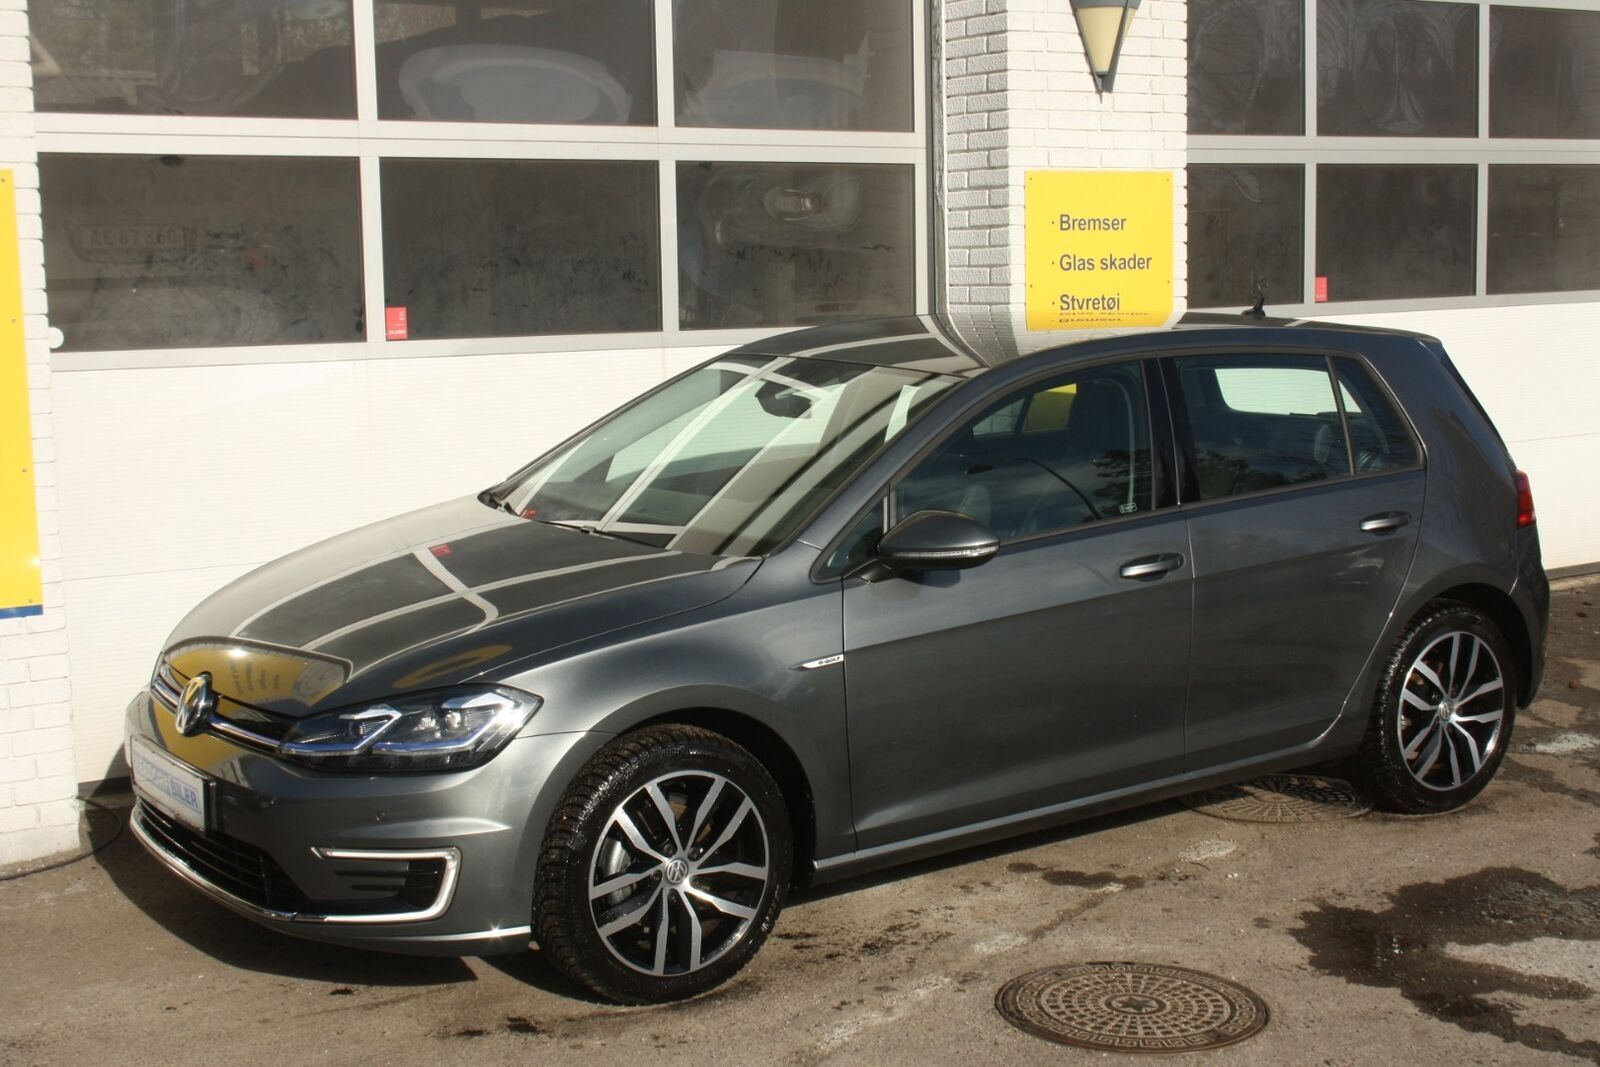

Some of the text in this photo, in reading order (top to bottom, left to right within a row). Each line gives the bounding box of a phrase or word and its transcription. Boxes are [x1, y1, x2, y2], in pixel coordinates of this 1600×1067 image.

[1059, 214, 1127, 231] Bremser
[1059, 253, 1152, 271] Glas skader
